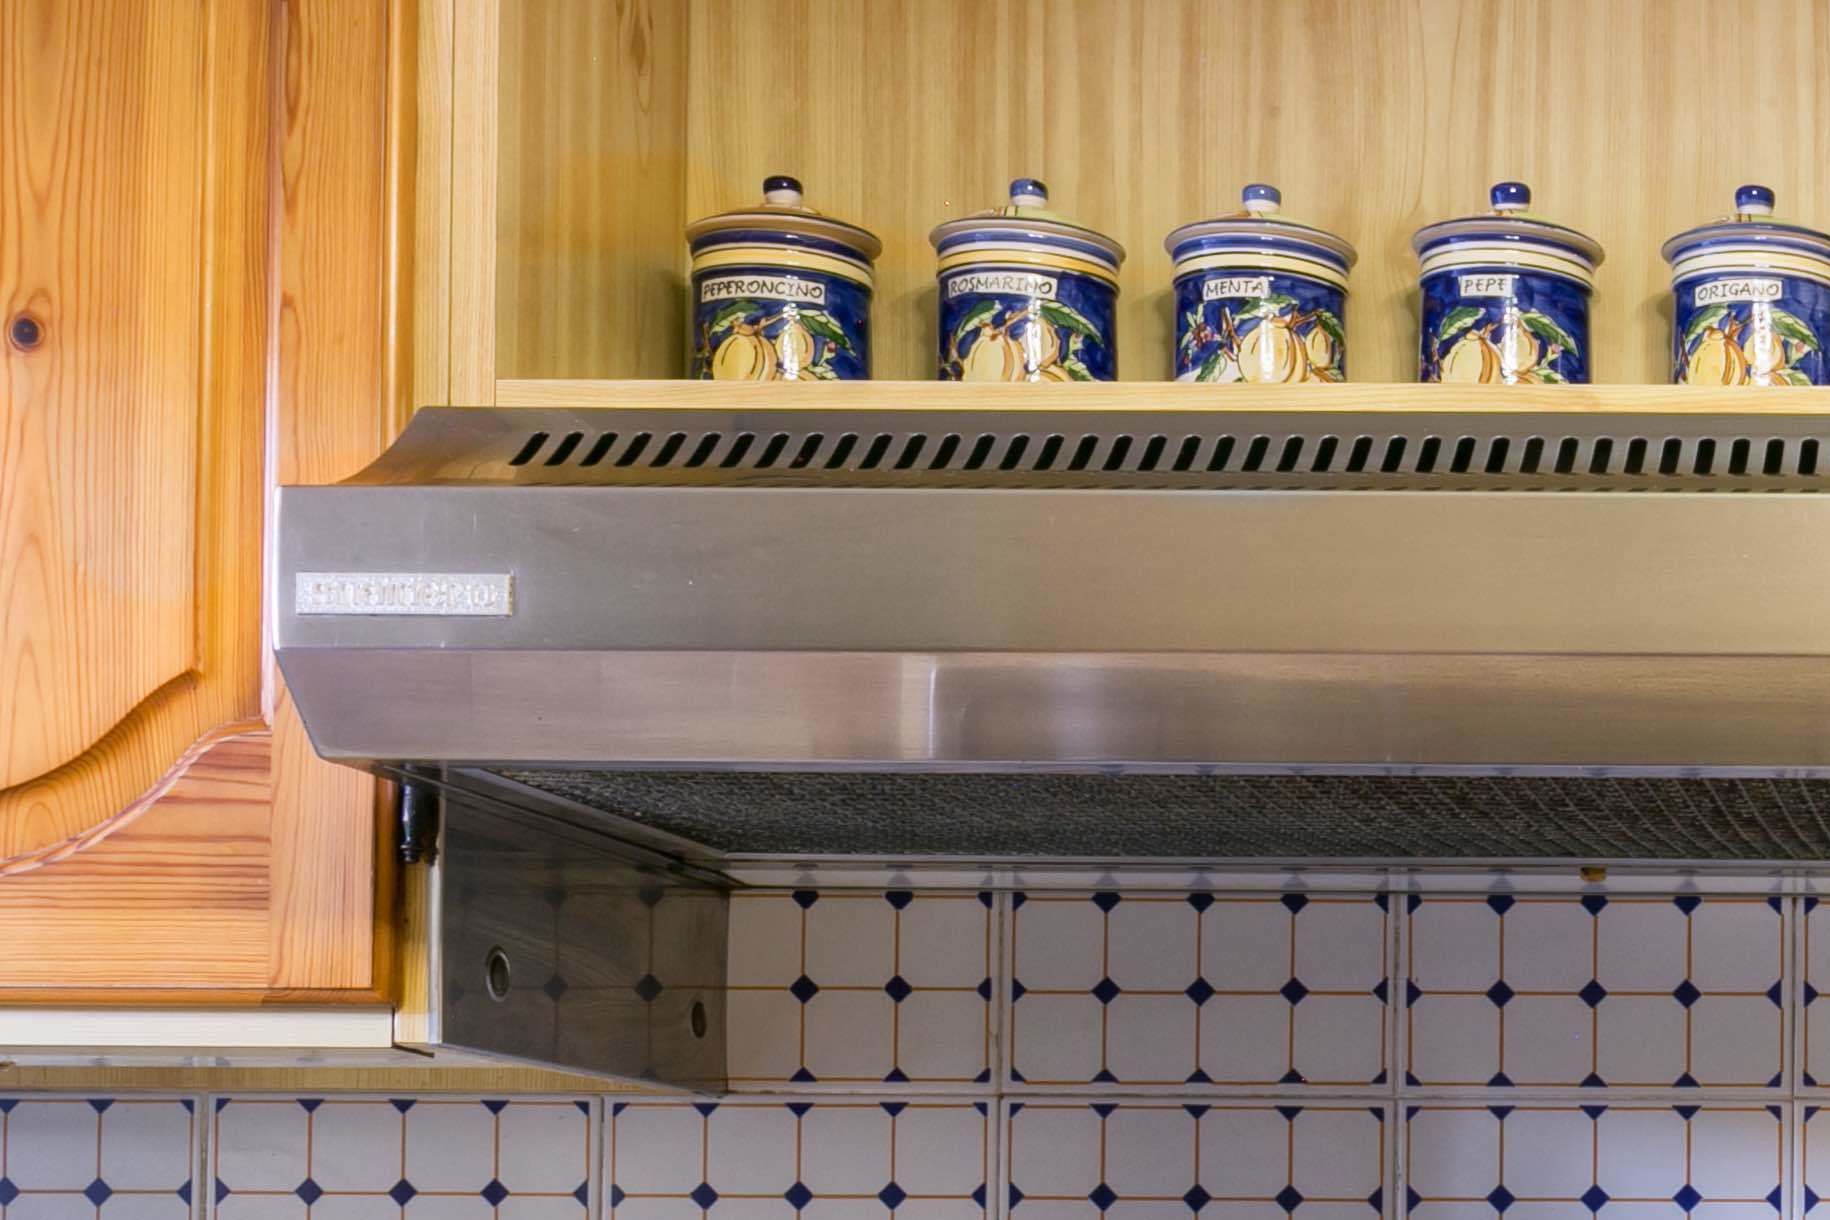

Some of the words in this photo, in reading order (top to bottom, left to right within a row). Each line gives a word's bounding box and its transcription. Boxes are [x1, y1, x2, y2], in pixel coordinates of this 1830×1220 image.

[703, 279, 824, 299] PEPERONCINO
[950, 276, 1053, 295] ROSMARINO
[1205, 279, 1265, 297] MENTA
[1463, 277, 1507, 294] PEPE
[1697, 282, 1780, 301] ORIGANO
